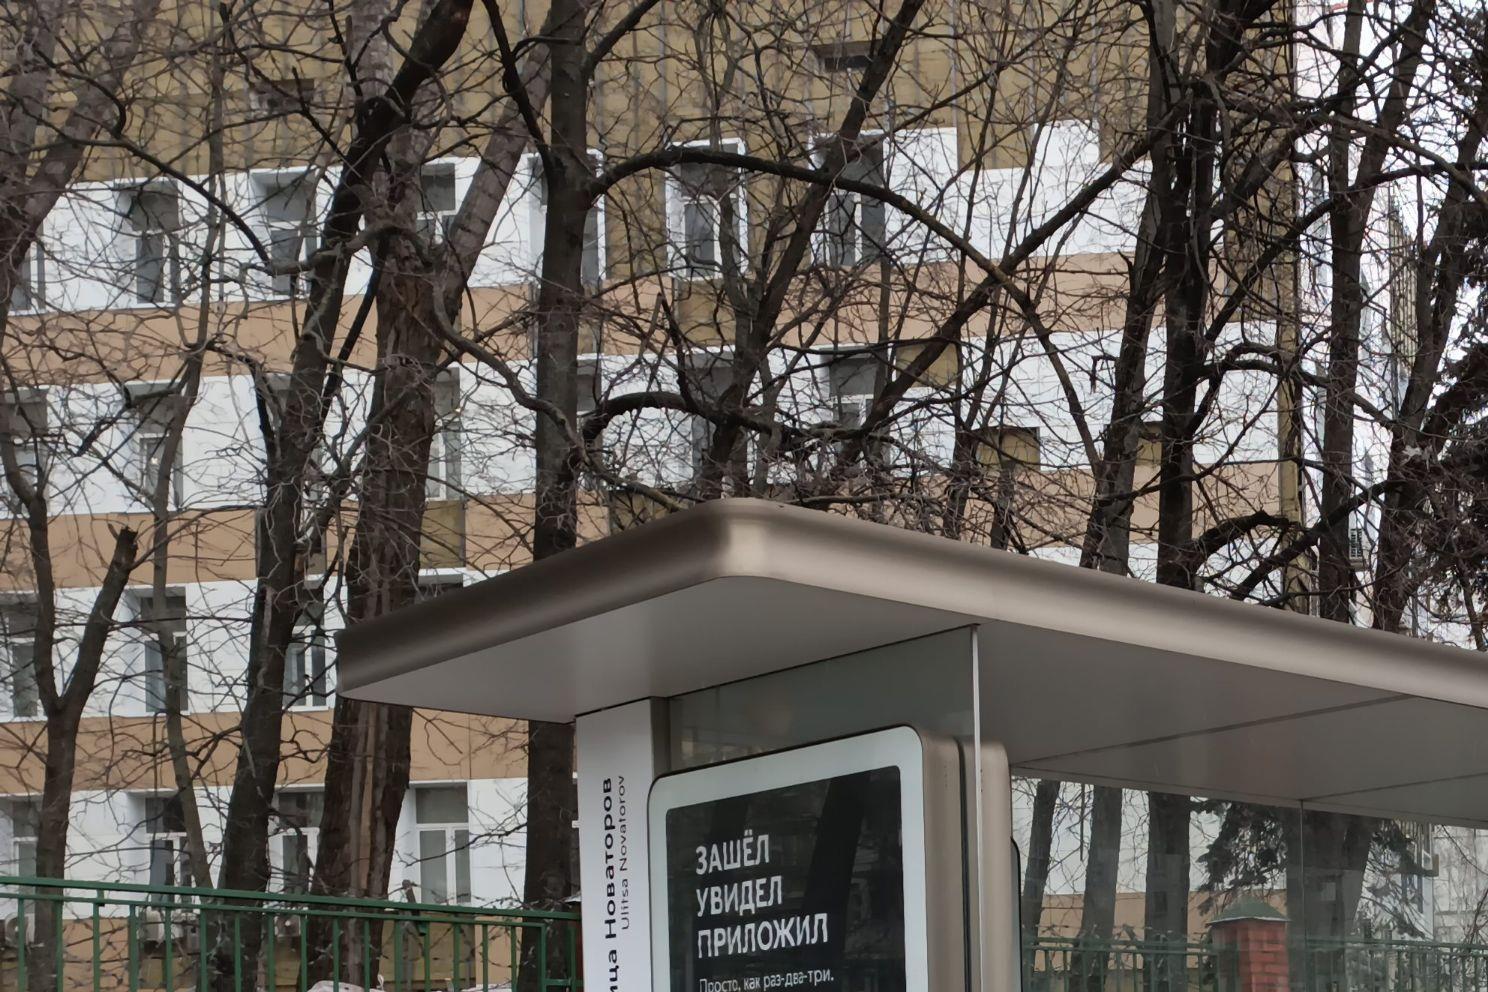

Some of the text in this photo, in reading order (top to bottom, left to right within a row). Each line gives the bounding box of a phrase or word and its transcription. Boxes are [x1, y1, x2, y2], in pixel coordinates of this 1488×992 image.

[603, 777, 617, 940] Новаторов
[618, 775, 630, 931] Ulitsa Novatorov
[695, 829, 770, 875] ЗАШЁЛ
[696, 875, 782, 917] УВИДЕЛ
[697, 912, 828, 959] ПРИЛОЖИЛ
[743, 976, 760, 991] как
[763, 968, 834, 991] раз-два-три.
